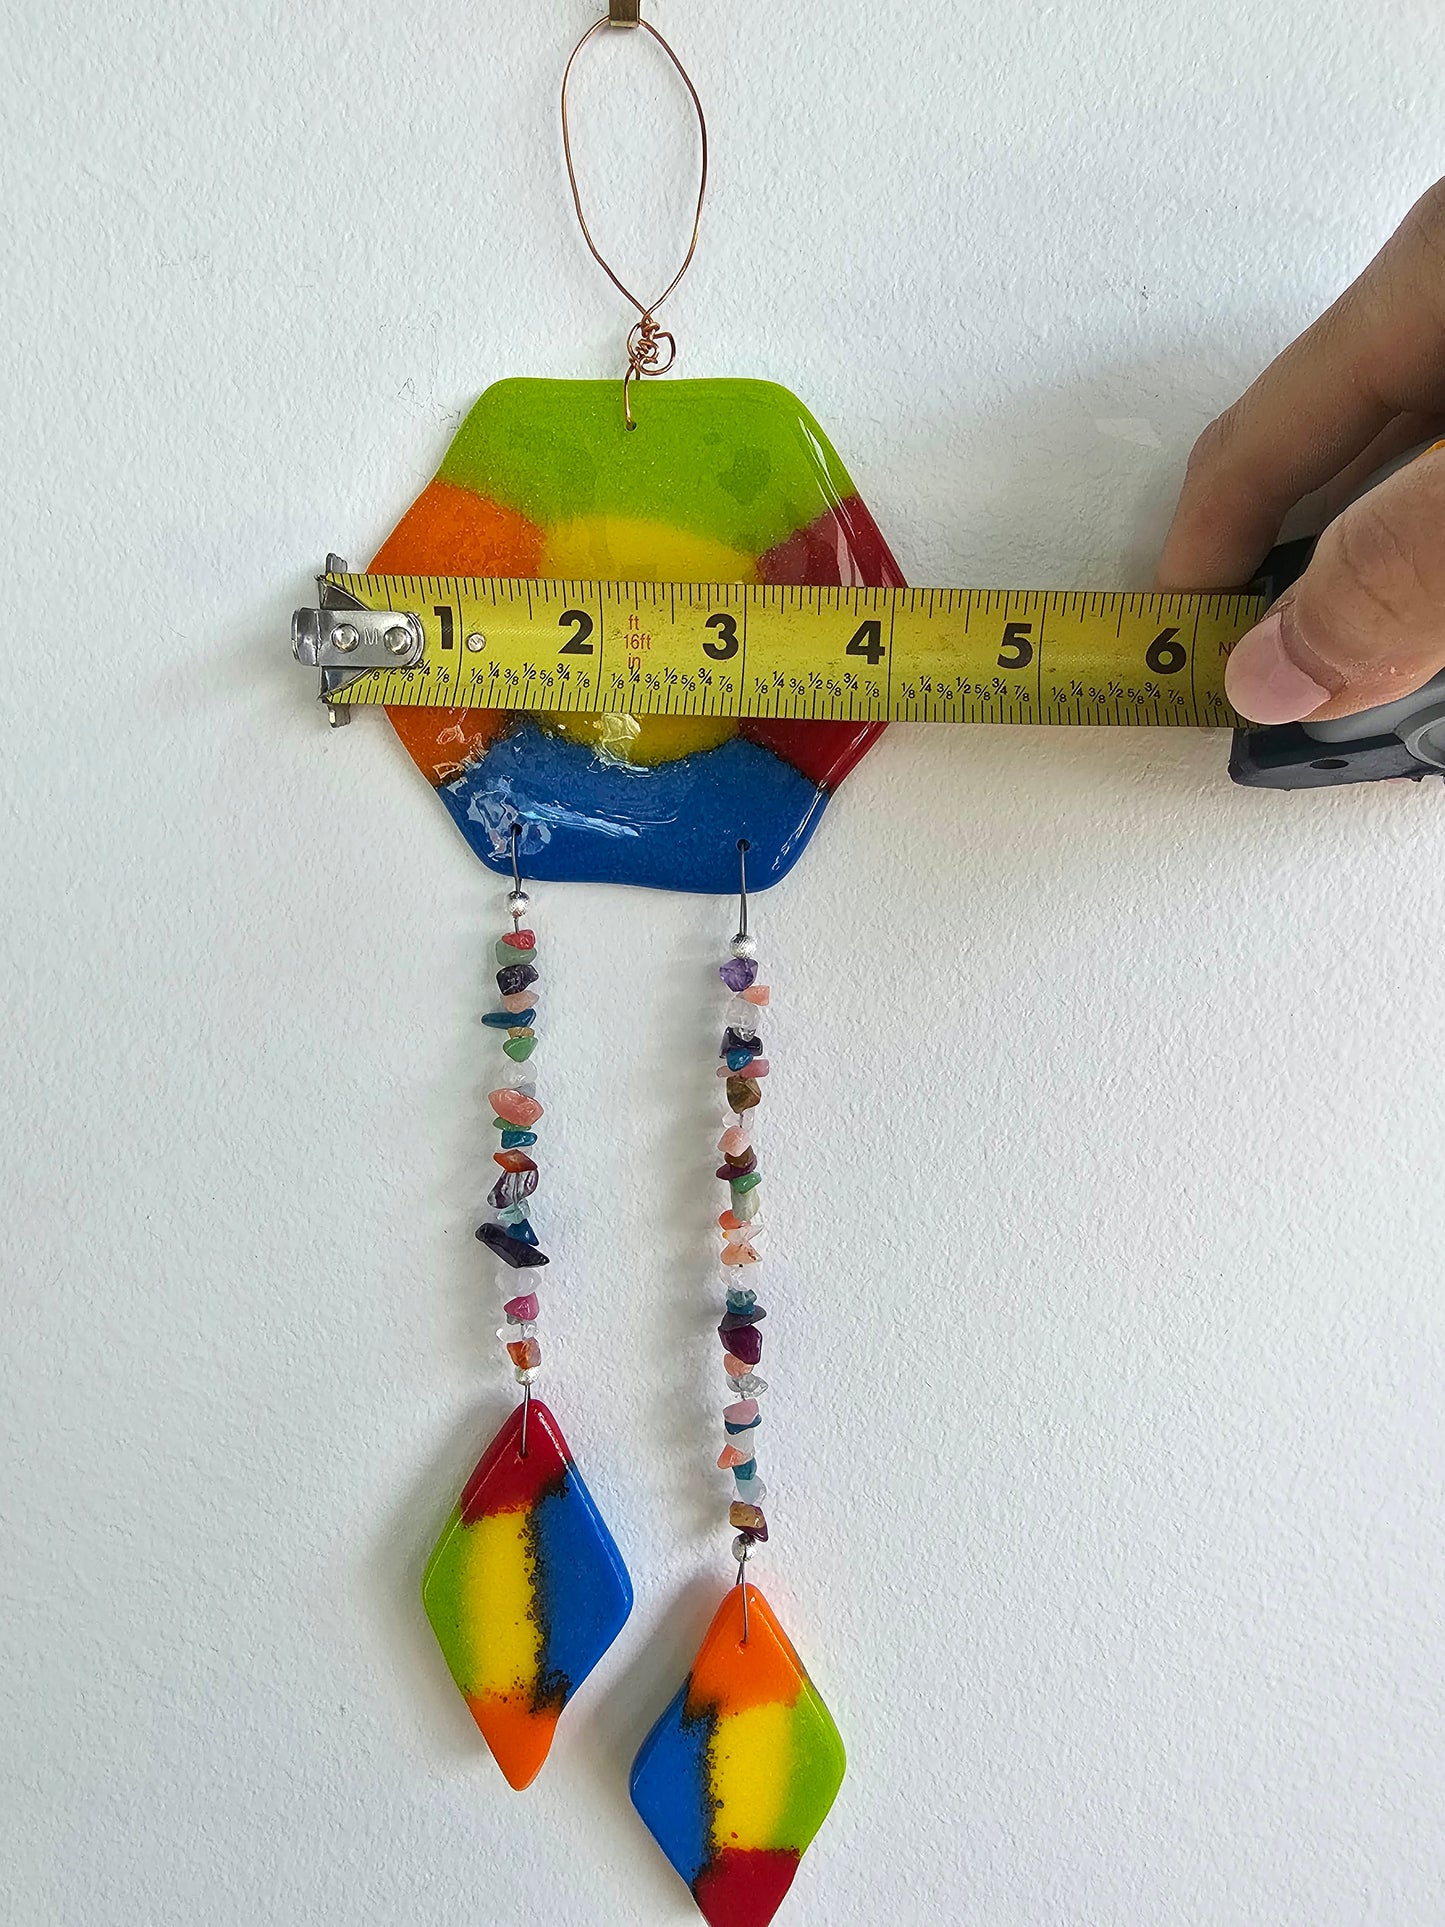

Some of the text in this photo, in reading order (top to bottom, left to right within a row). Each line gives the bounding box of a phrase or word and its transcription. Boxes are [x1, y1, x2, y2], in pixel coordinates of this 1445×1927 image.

[628, 614, 639, 631] ft
[364, 627, 379, 645] M
[434, 606, 1187, 674] 1 2 3 4 5 6
[623, 633, 651, 650] 16ft
[628, 653, 641, 669] in
